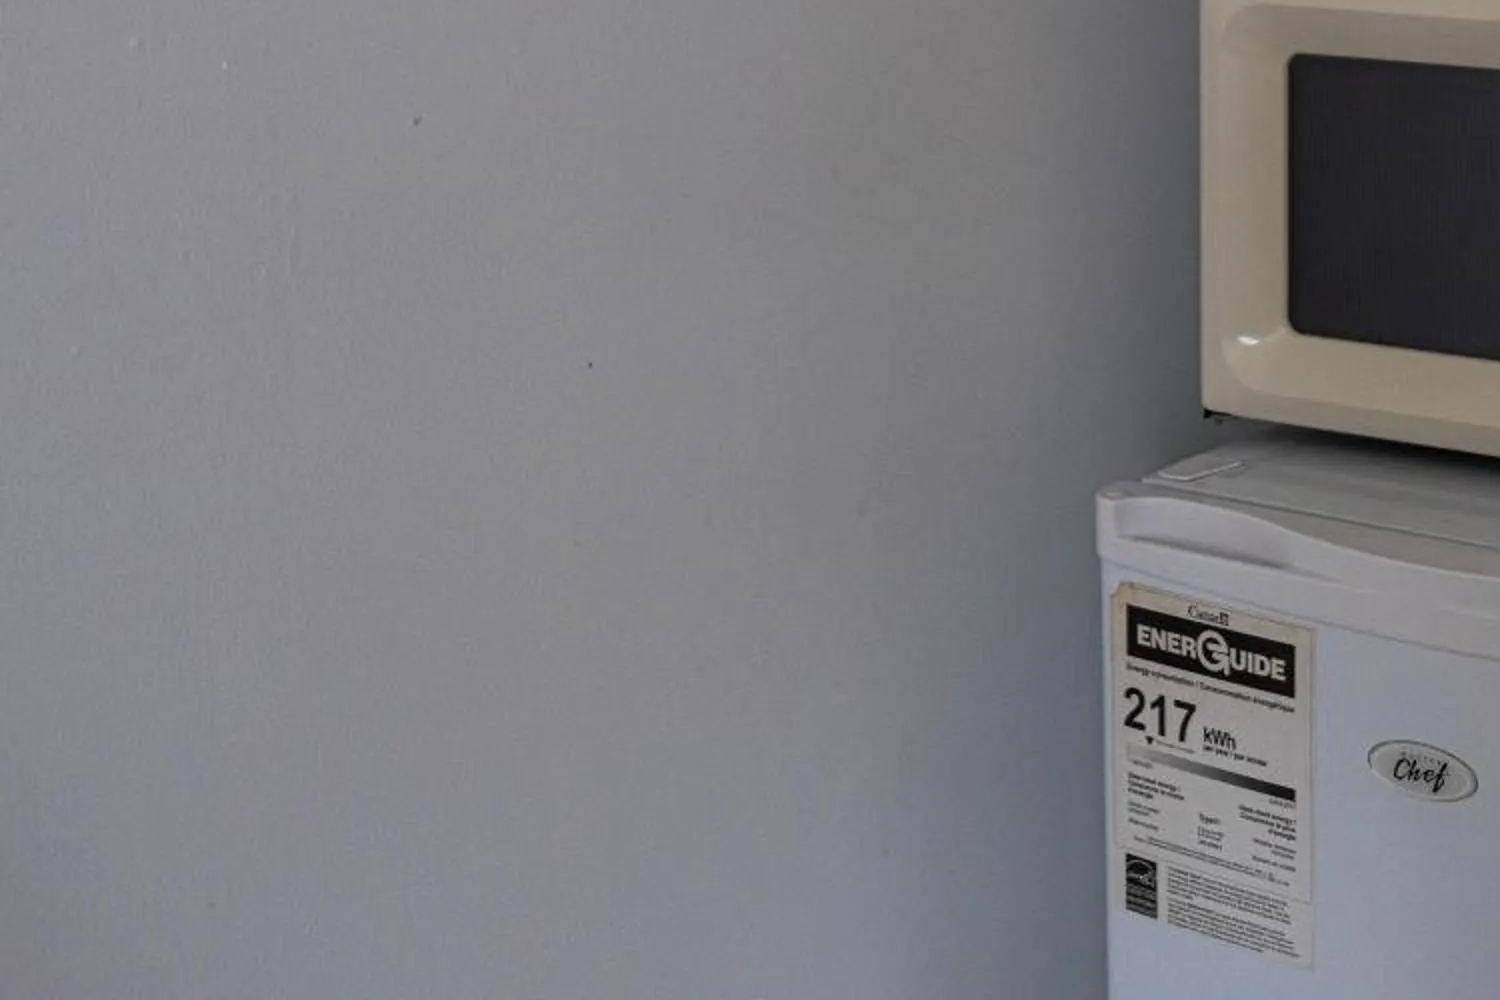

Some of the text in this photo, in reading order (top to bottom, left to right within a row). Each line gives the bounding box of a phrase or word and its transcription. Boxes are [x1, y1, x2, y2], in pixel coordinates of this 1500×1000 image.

[1136, 623, 1287, 681] ENERGUIDE
[1124, 687, 1197, 742] 217
[1203, 727, 1237, 750] kWh
[1393, 757, 1448, 793] Chef
